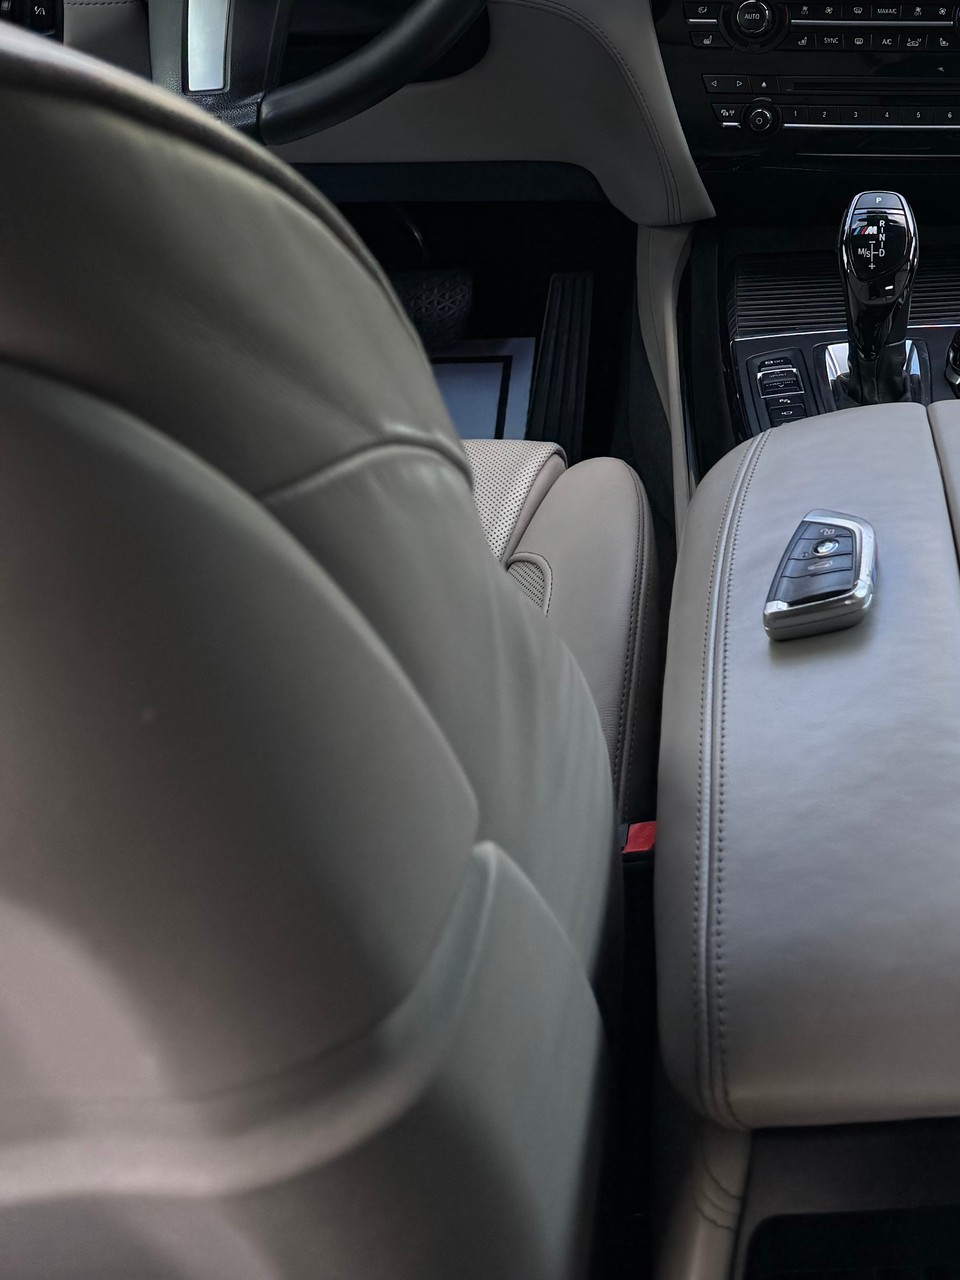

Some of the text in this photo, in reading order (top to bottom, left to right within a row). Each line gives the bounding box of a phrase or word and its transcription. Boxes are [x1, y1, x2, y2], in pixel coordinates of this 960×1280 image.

[881, 38, 893, 46] A/C
[879, 233, 886, 241] N
[858, 248, 871, 258] M/S
[879, 249, 886, 257] D
